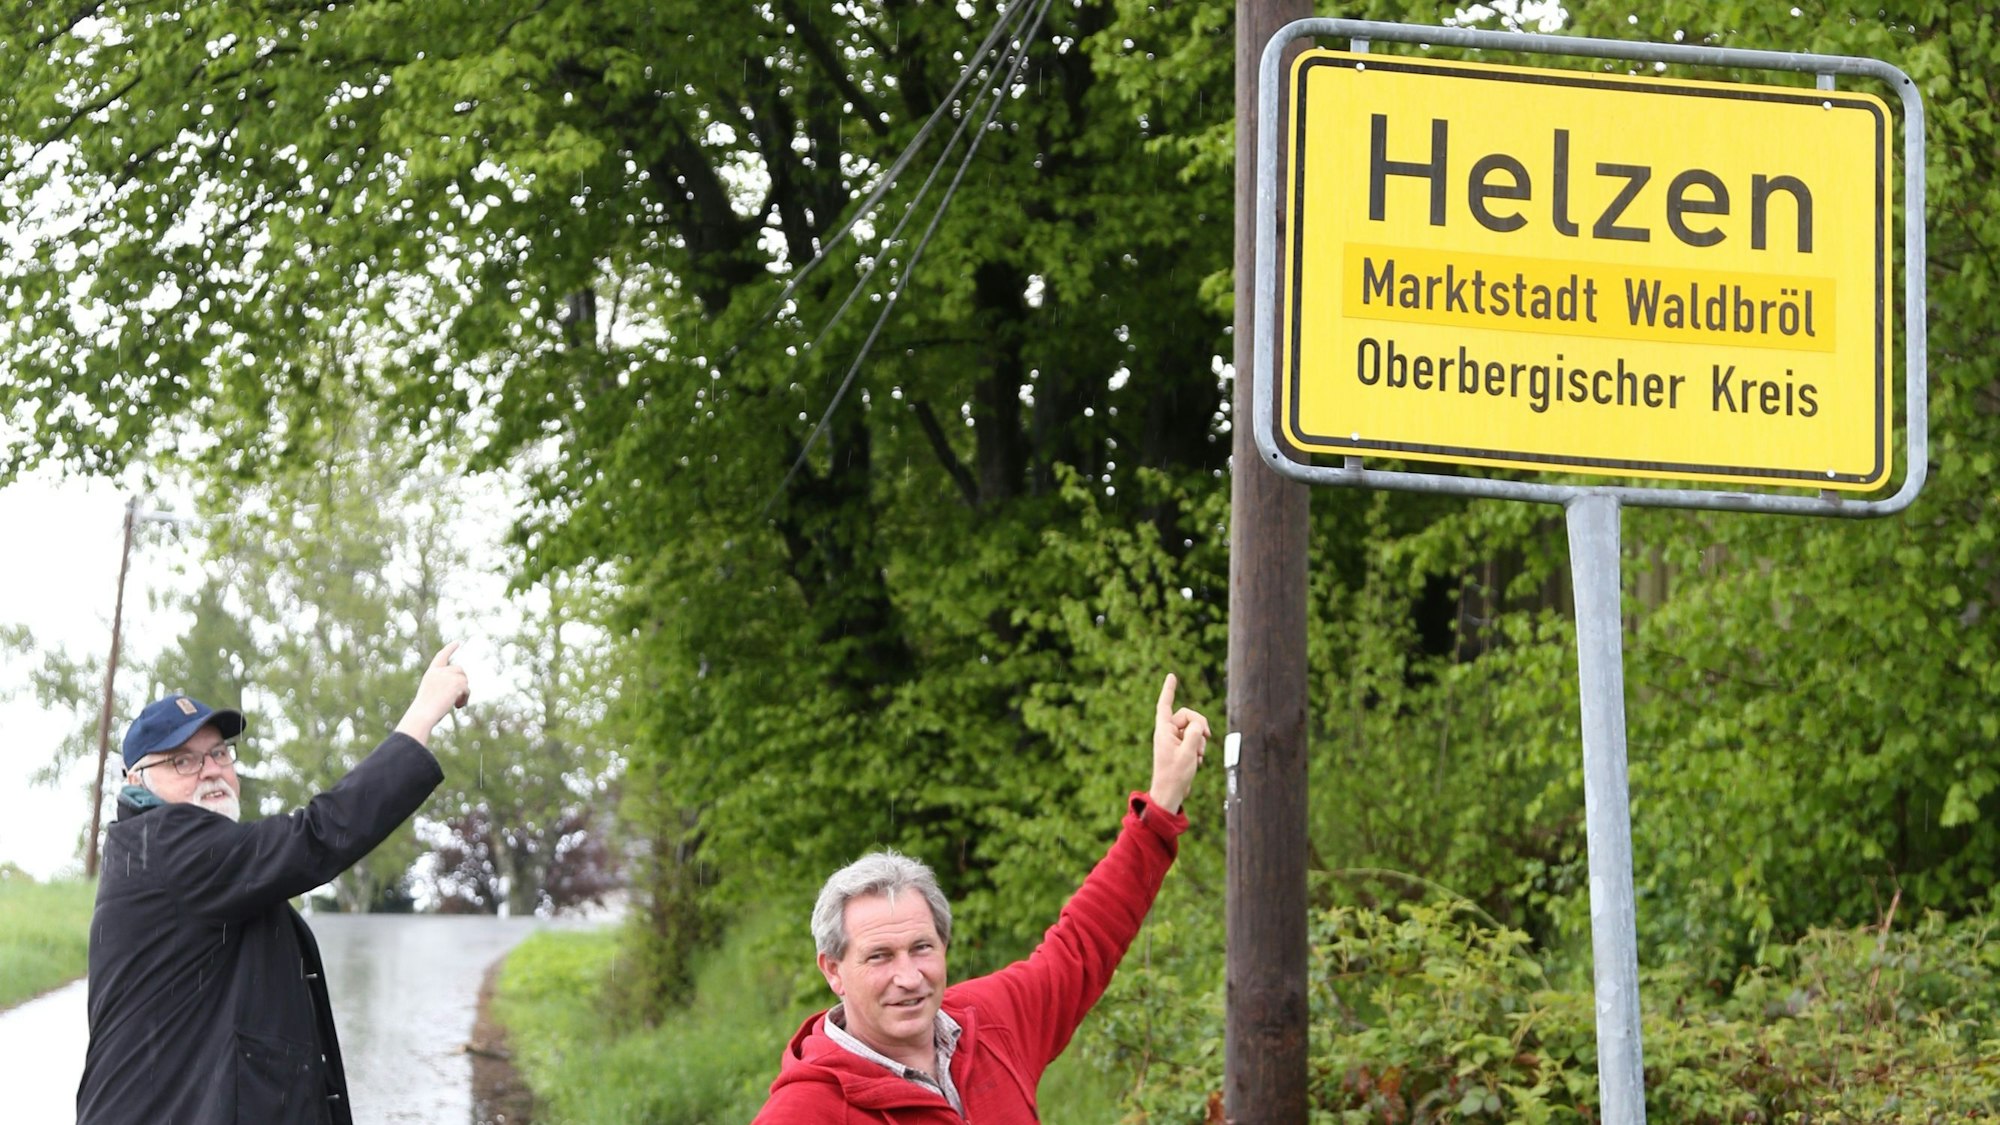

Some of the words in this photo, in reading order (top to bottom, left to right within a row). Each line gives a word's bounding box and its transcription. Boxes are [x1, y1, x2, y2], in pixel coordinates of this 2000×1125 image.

[1368, 113, 1813, 254] Helzen
[1362, 257, 1598, 323] Marktstadt
[1624, 278, 1816, 337] Waldbröl
[1357, 337, 1686, 413] Oberbergischer
[1712, 364, 1818, 418] Kreis
